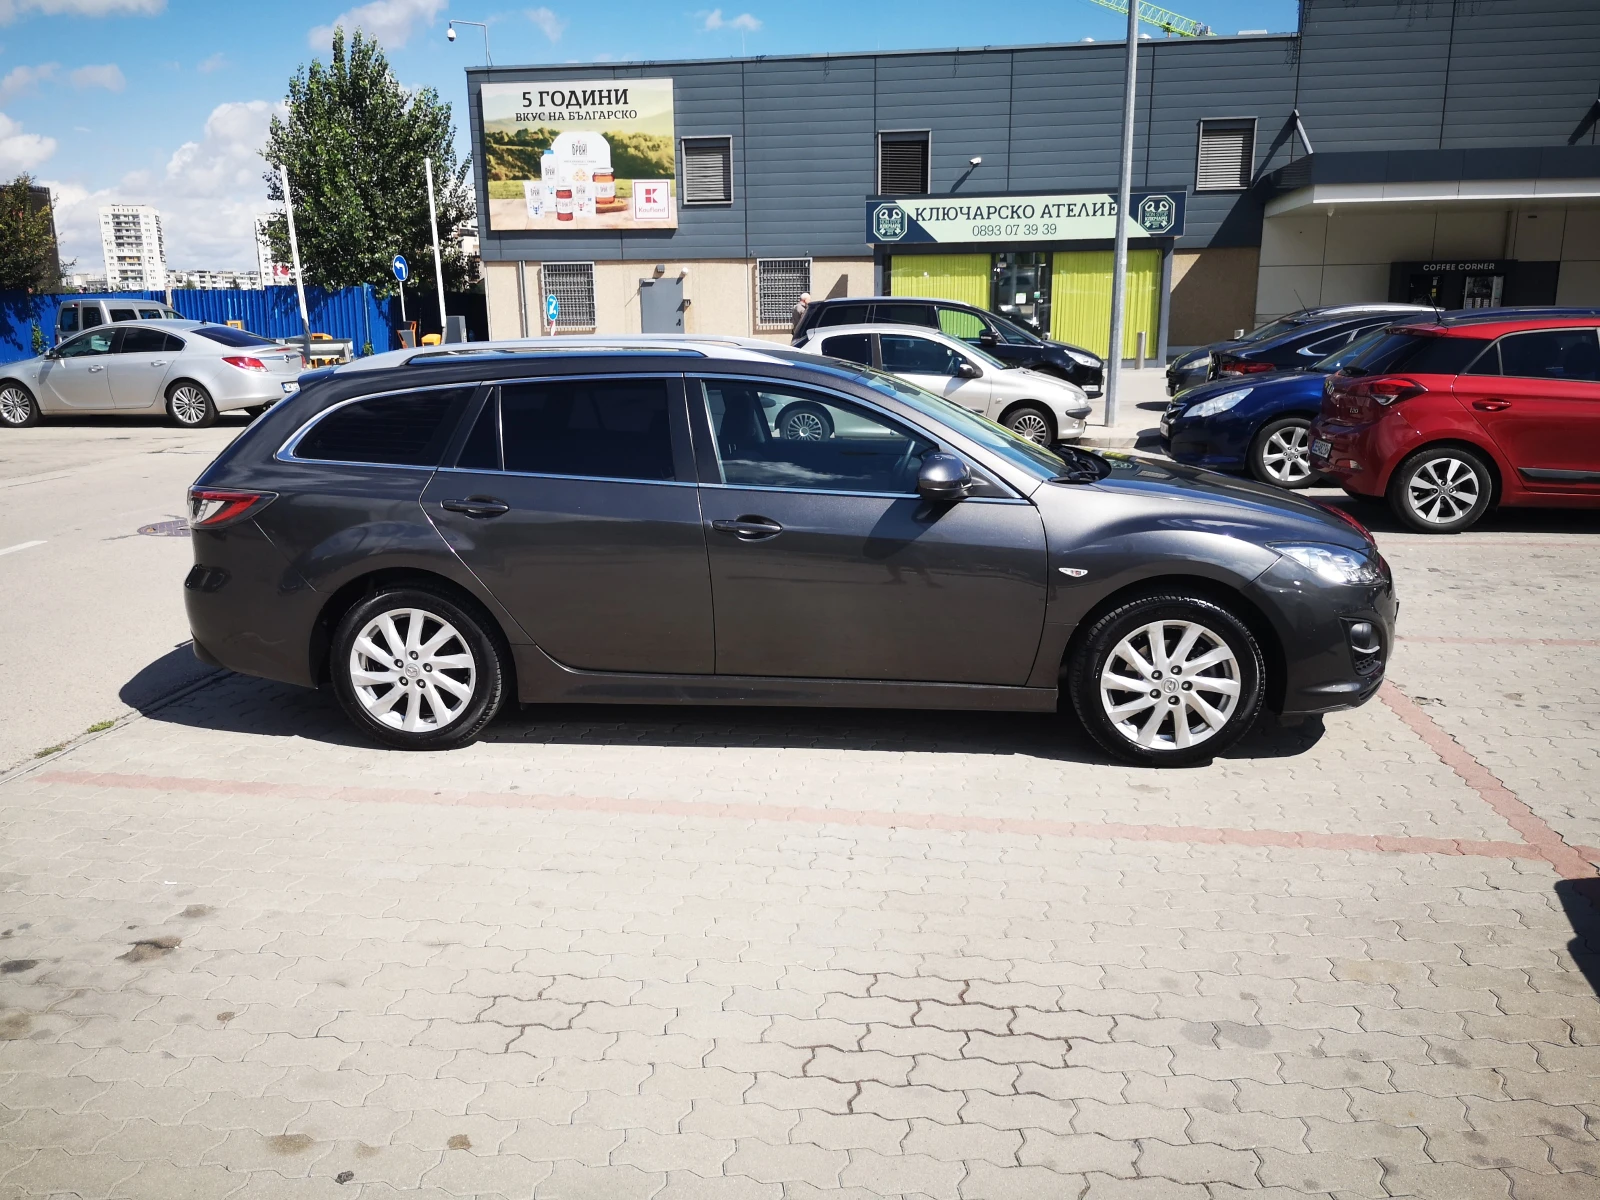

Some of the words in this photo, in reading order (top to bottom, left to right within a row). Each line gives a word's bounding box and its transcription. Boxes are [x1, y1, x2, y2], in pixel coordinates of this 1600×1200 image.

[522, 91, 532, 108] 5
[538, 88, 629, 109] ГОДИНИ
[515, 112, 546, 122] ВКУС
[548, 111, 565, 121] НА
[568, 109, 638, 121] БЪЛГАРСКО
[914, 204, 1035, 221] КЛЮЧАРСКО
[1039, 202, 1118, 219] АТЕЛИЕ
[972, 224, 1002, 236] 0893
[1005, 224, 1020, 235] 07
[1023, 223, 1039, 236] 39
[1041, 223, 1057, 235] 39
[1423, 263, 1456, 271] COFFEE
[1458, 262, 1495, 271] CORNER
